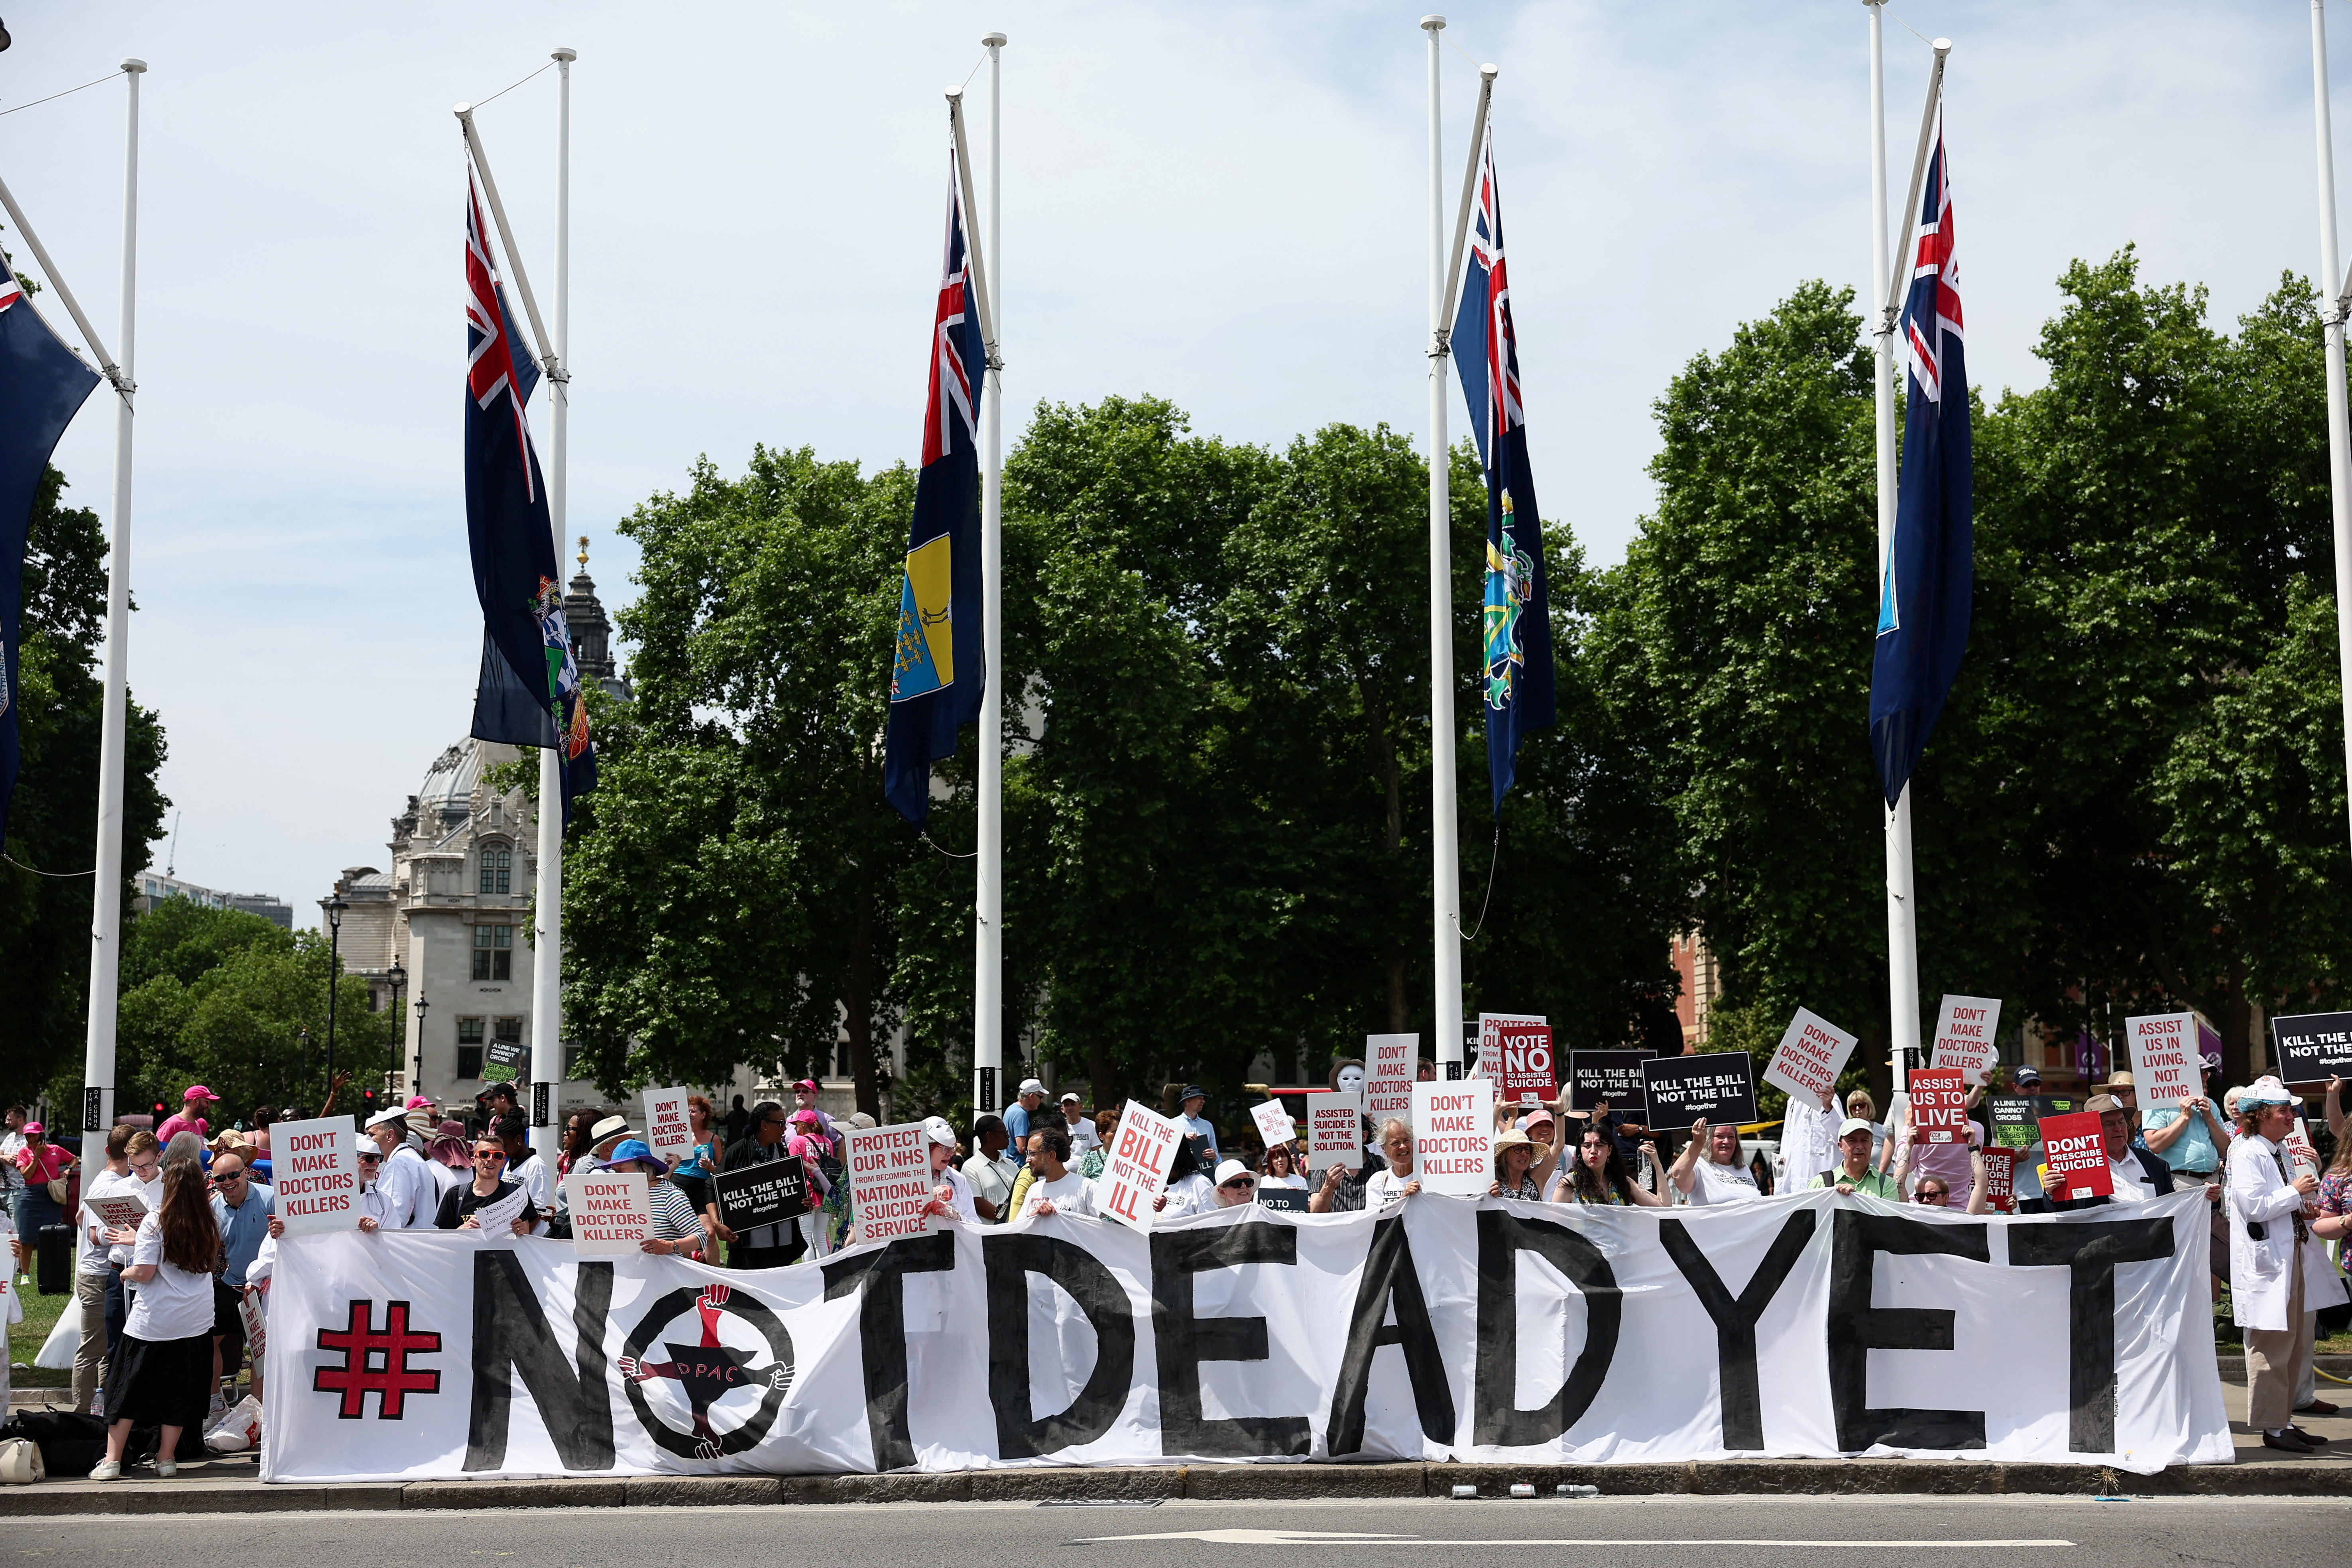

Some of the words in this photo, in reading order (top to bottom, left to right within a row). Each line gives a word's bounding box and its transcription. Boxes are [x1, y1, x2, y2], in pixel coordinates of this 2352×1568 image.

[1953, 1007, 1987, 1021] DON'T
[1950, 1023, 1983, 1037] MAKE
[2138, 1020, 2182, 1036] ASSIST
[1503, 1035, 1549, 1049] VOTE
[1803, 1023, 1840, 1050] DON'T
[2145, 1038, 2163, 1051] US
[2167, 1036, 2180, 1049] IN
[2283, 1035, 2315, 1047] KILL
[2317, 1032, 2347, 1044] THE
[1378, 1046, 1407, 1059] DON'T
[1797, 1037, 1832, 1064] MAKE
[1938, 1038, 1989, 1054] DOCTORS
[2290, 1046, 2320, 1058] NOT
[2323, 1043, 2352, 1055] THE
[490, 1054, 509, 1062] CROSS
[491, 1049, 515, 1058] CANNOT
[1505, 1048, 1550, 1072] NO
[2143, 1052, 2187, 1066] LIVING,
[1780, 1045, 1833, 1082] DOCTORS
[1939, 1055, 1983, 1069] KILLERS
[485, 1069, 514, 1079] ASSISTING
[986, 1069, 989, 1078] ST
[1377, 1063, 1405, 1076] MAKE
[1577, 1069, 1601, 1078] KILL
[1604, 1069, 1626, 1078] THE
[1776, 1060, 1823, 1093] KILLERS
[2154, 1069, 2179, 1083] NOT
[484, 1074, 506, 1082] SUICIDE
[1507, 1078, 1552, 1088] SUICIDE
[1581, 1079, 1605, 1088] NOT
[1608, 1079, 1629, 1088] THE
[1650, 1080, 1681, 1092] KILL
[1684, 1076, 1712, 1088] THE
[1715, 1074, 1745, 1086] BILL
[1912, 1078, 1961, 1090] ASSIST
[1368, 1080, 1412, 1094] DOCTORS
[2150, 1084, 2189, 1100] DYING
[94, 1090, 98, 1099] DA
[1657, 1091, 1686, 1104] NOT
[1689, 1088, 1718, 1100] THE
[1721, 1086, 1742, 1098] ILL
[1912, 1092, 1935, 1105] US
[1940, 1091, 1963, 1105] TO
[655, 1101, 678, 1112] DON'T
[1370, 1097, 1408, 1111] KILLERS
[1431, 1095, 1475, 1111] DON'T
[1685, 1102, 1717, 1111] #together
[657, 1112, 679, 1123] MAKE
[1270, 1108, 1281, 1116] THE
[1315, 1109, 1353, 1118] ASSISTED
[1914, 1108, 1965, 1126] LIVE
[1129, 1110, 1149, 1132] KILL
[1153, 1121, 1175, 1143] THE
[1266, 1116, 1279, 1125] BILL
[1274, 1120, 1286, 1128] THE
[1314, 1120, 1346, 1129] SUICIDE
[1432, 1116, 1475, 1132] MAKE
[652, 1122, 688, 1136] DOCTORS
[1318, 1131, 1334, 1140] NOT
[1336, 1131, 1352, 1139] THE
[290, 1132, 336, 1152] DON'T
[655, 1134, 687, 1147] KILLERS.
[852, 1129, 921, 1153] PROTECT
[1314, 1142, 1356, 1151] SOLUTION.
[1419, 1137, 1488, 1153] DOCTORS
[2047, 1134, 2099, 1154] DON'T
[2285, 1136, 2303, 1146] THE
[1118, 1127, 1163, 1175] BILL
[2050, 1149, 2102, 1162] PRESCRIBE
[292, 1153, 338, 1173] MAKE
[853, 1154, 887, 1172] OUR
[891, 1149, 924, 1167] NHS
[1424, 1158, 1483, 1175] KILLERS
[1986, 1163, 2010, 1172] LIFE
[2051, 1157, 2104, 1172] SUICIDE
[855, 1176, 874, 1184] FROM
[876, 1171, 911, 1182] BECOMING
[1112, 1159, 1135, 1180] NOT
[1136, 1170, 1157, 1193] THE
[280, 1173, 353, 1196] DOCTORS
[584, 1184, 629, 1196] DON'T
[723, 1189, 749, 1202] KILL
[751, 1181, 773, 1194] THE
[775, 1175, 800, 1188] BILL
[729, 1197, 753, 1210] NOT
[756, 1190, 779, 1204] THE
[781, 1186, 798, 1197] ILL
[856, 1181, 928, 1204] NATIONAL
[287, 1194, 350, 1216] KILLERS
[485, 1203, 505, 1216] Jesus
[506, 1192, 520, 1205] said
[502, 1206, 516, 1215] come
[517, 1198, 525, 1207] that
[587, 1199, 632, 1210] MAKE
[753, 1203, 779, 1214] #together
[1109, 1181, 1138, 1222] ILL
[865, 1199, 922, 1220] SUICIDE
[485, 1224, 496, 1232] they
[498, 1216, 508, 1226] may
[509, 1210, 520, 1219] have
[576, 1214, 647, 1226] DOCTORS
[583, 1229, 644, 1240] KILLERS
[865, 1217, 927, 1238] SERVICE
[246, 1307, 257, 1324] DON'T
[249, 1319, 260, 1335] MAKE
[250, 1328, 266, 1349] DOCTORS
[677, 1363, 738, 1382] DPAC
